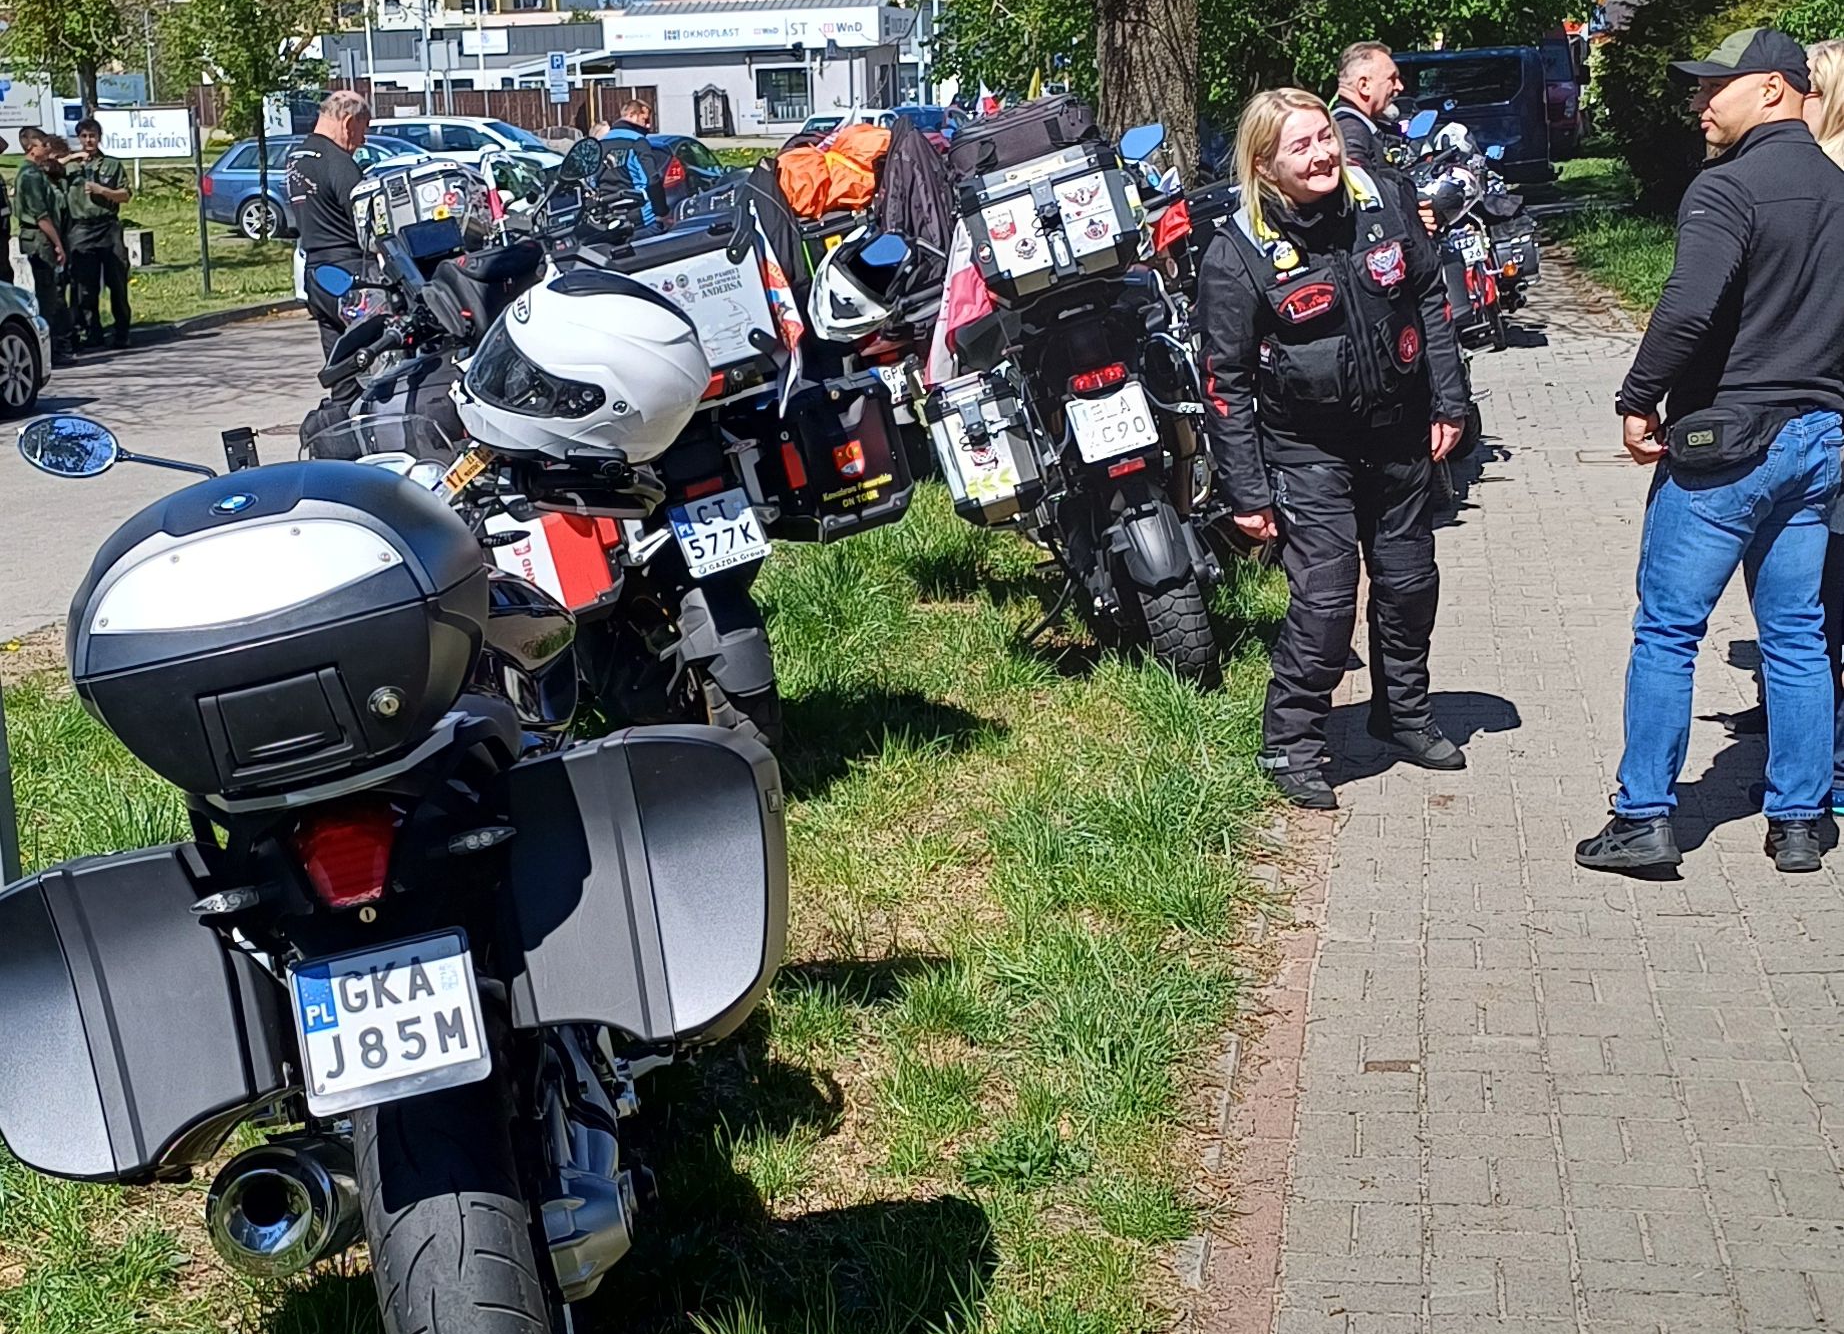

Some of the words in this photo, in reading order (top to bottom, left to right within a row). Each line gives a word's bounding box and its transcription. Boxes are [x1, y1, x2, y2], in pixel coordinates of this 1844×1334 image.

[682, 28, 740, 39] OKNOPLAST
[836, 22, 863, 33] WnD
[129, 111, 156, 128] Plac
[102, 132, 133, 149] Ofiar
[137, 132, 188, 149] Piaśnicy
[702, 280, 743, 299] ANDERSA
[842, 497, 855, 508] ON
[855, 489, 880, 503] TOUR
[696, 499, 725, 525] CT
[678, 524, 694, 538] PL
[688, 521, 758, 559] 577K
[709, 556, 738, 570] GAZDA
[739, 549, 766, 561] Group
[338, 955, 435, 1013] GKA
[305, 1004, 335, 1027] PL
[326, 1006, 469, 1079] J85M
